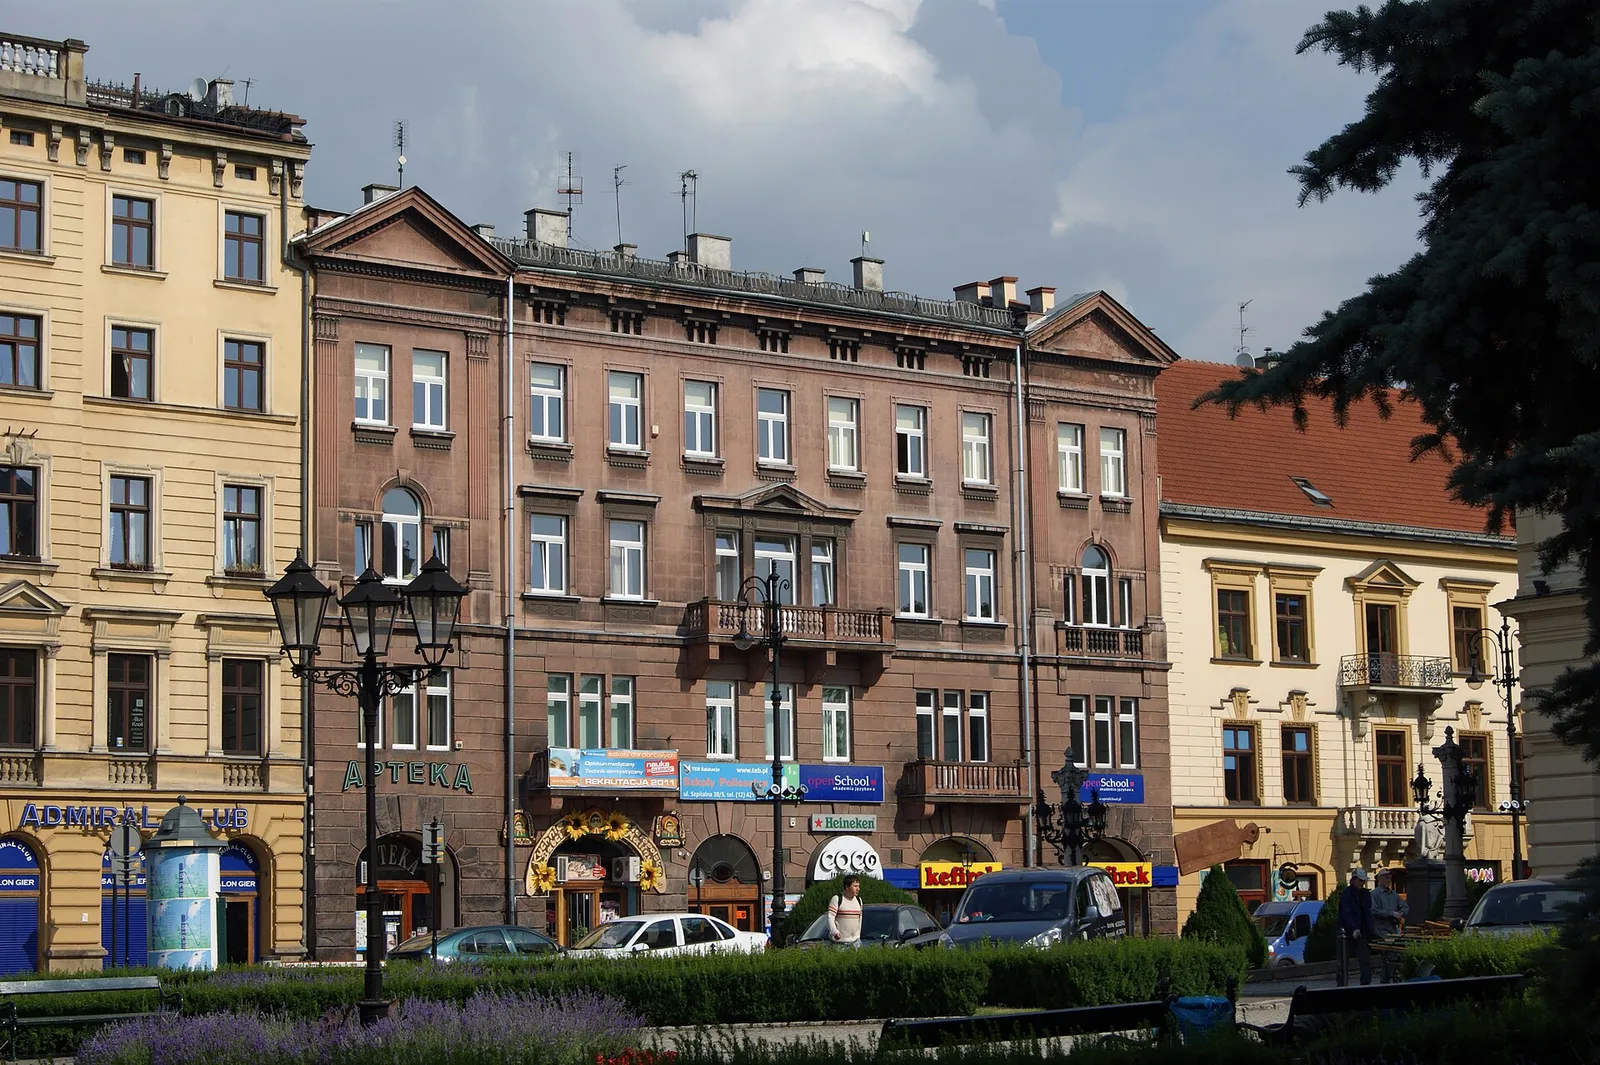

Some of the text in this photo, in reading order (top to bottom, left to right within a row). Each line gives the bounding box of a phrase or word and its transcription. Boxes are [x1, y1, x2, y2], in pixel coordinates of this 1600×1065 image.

[683, 776, 768, 788] Szkoły Policeale
[807, 775, 869, 788] openSchool
[18, 804, 249, 829] ADMIRAL LUB
[825, 816, 875, 828] Heineken
[17, 844, 32, 862] CLUB
[240, 847, 254, 864] CLUB
[378, 844, 420, 876] TEKA
[925, 866, 993, 886] kefir
[1107, 866, 1150, 884] irek
